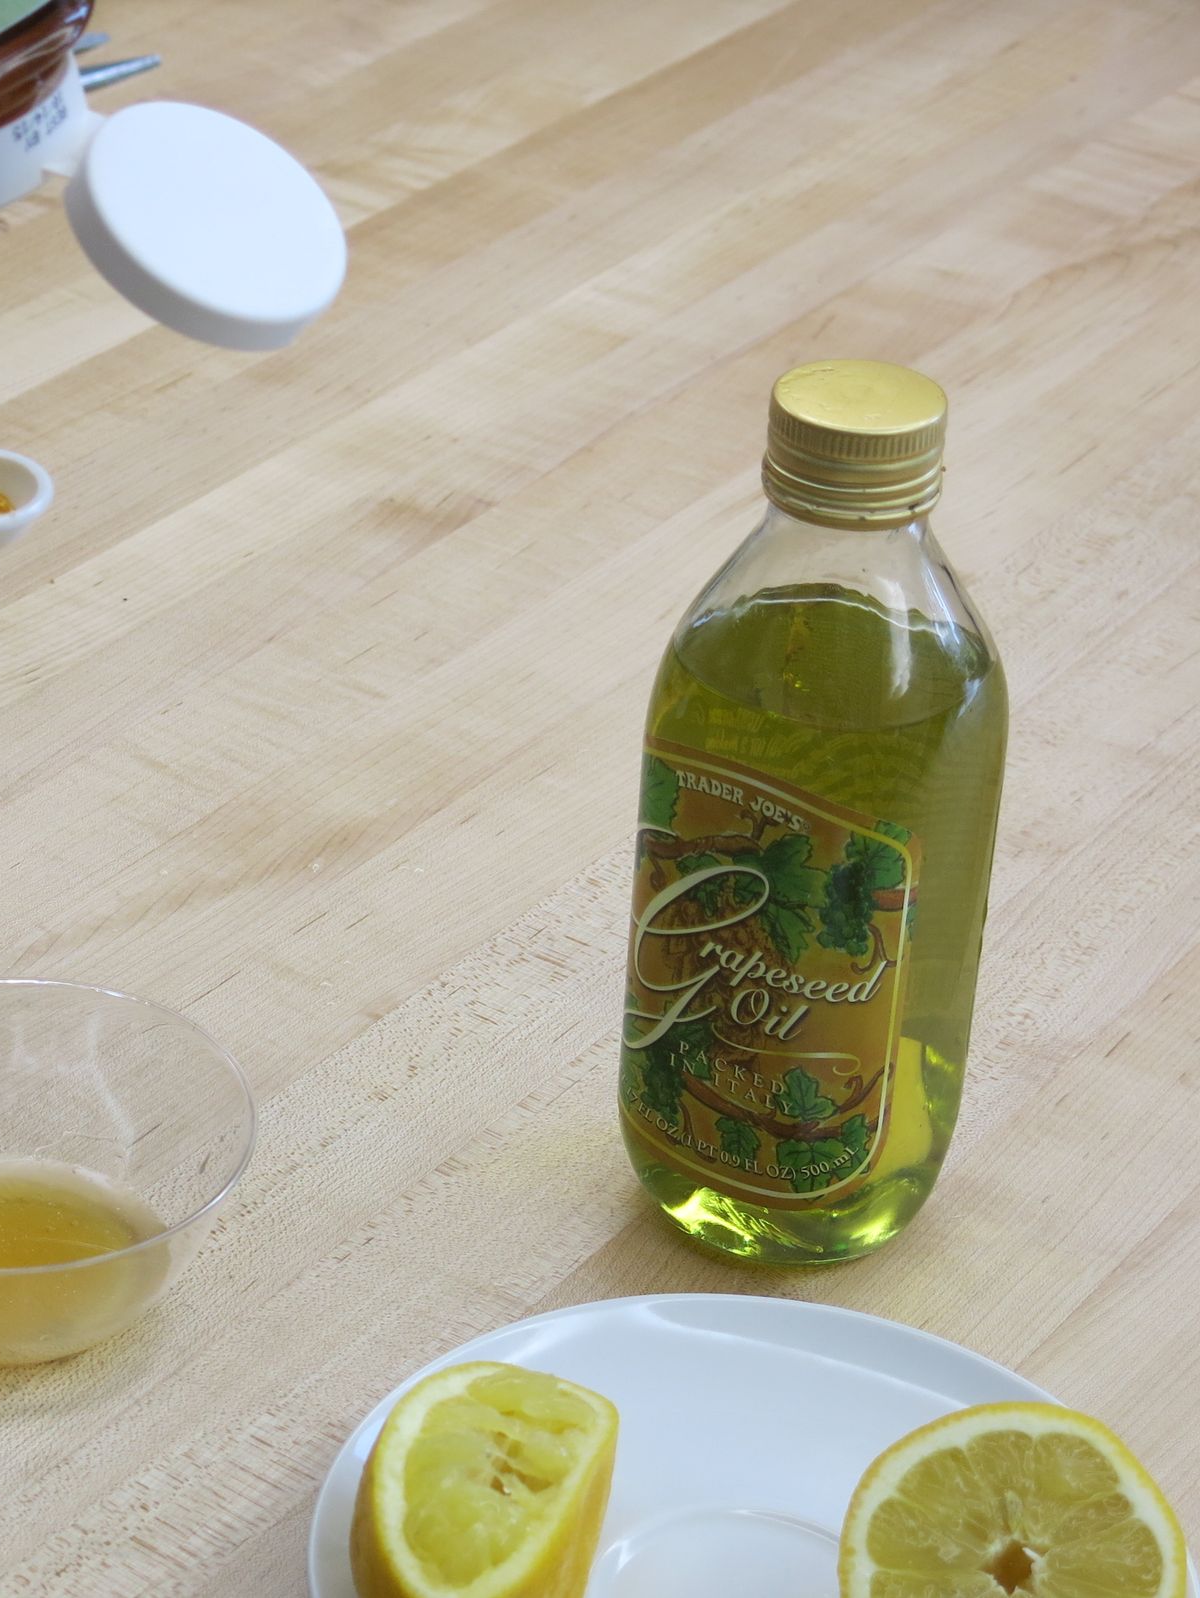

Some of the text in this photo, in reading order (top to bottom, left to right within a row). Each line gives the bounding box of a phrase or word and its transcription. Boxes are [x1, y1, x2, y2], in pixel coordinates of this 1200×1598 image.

[675, 770, 804, 832] TRADER JOE'S
[622, 865, 888, 1049] Grapeseed
[729, 988, 809, 1041] Oil
[669, 1053, 793, 1115] IN ITALY
[679, 1041, 785, 1095] PACKED
[697, 1140, 719, 1157] PT
[720, 1150, 741, 1168] 0.9
[745, 1158, 763, 1175] FL
[766, 1164, 796, 1179] OZ)
[800, 1161, 830, 1179] 500
[833, 1146, 859, 1167] mL
